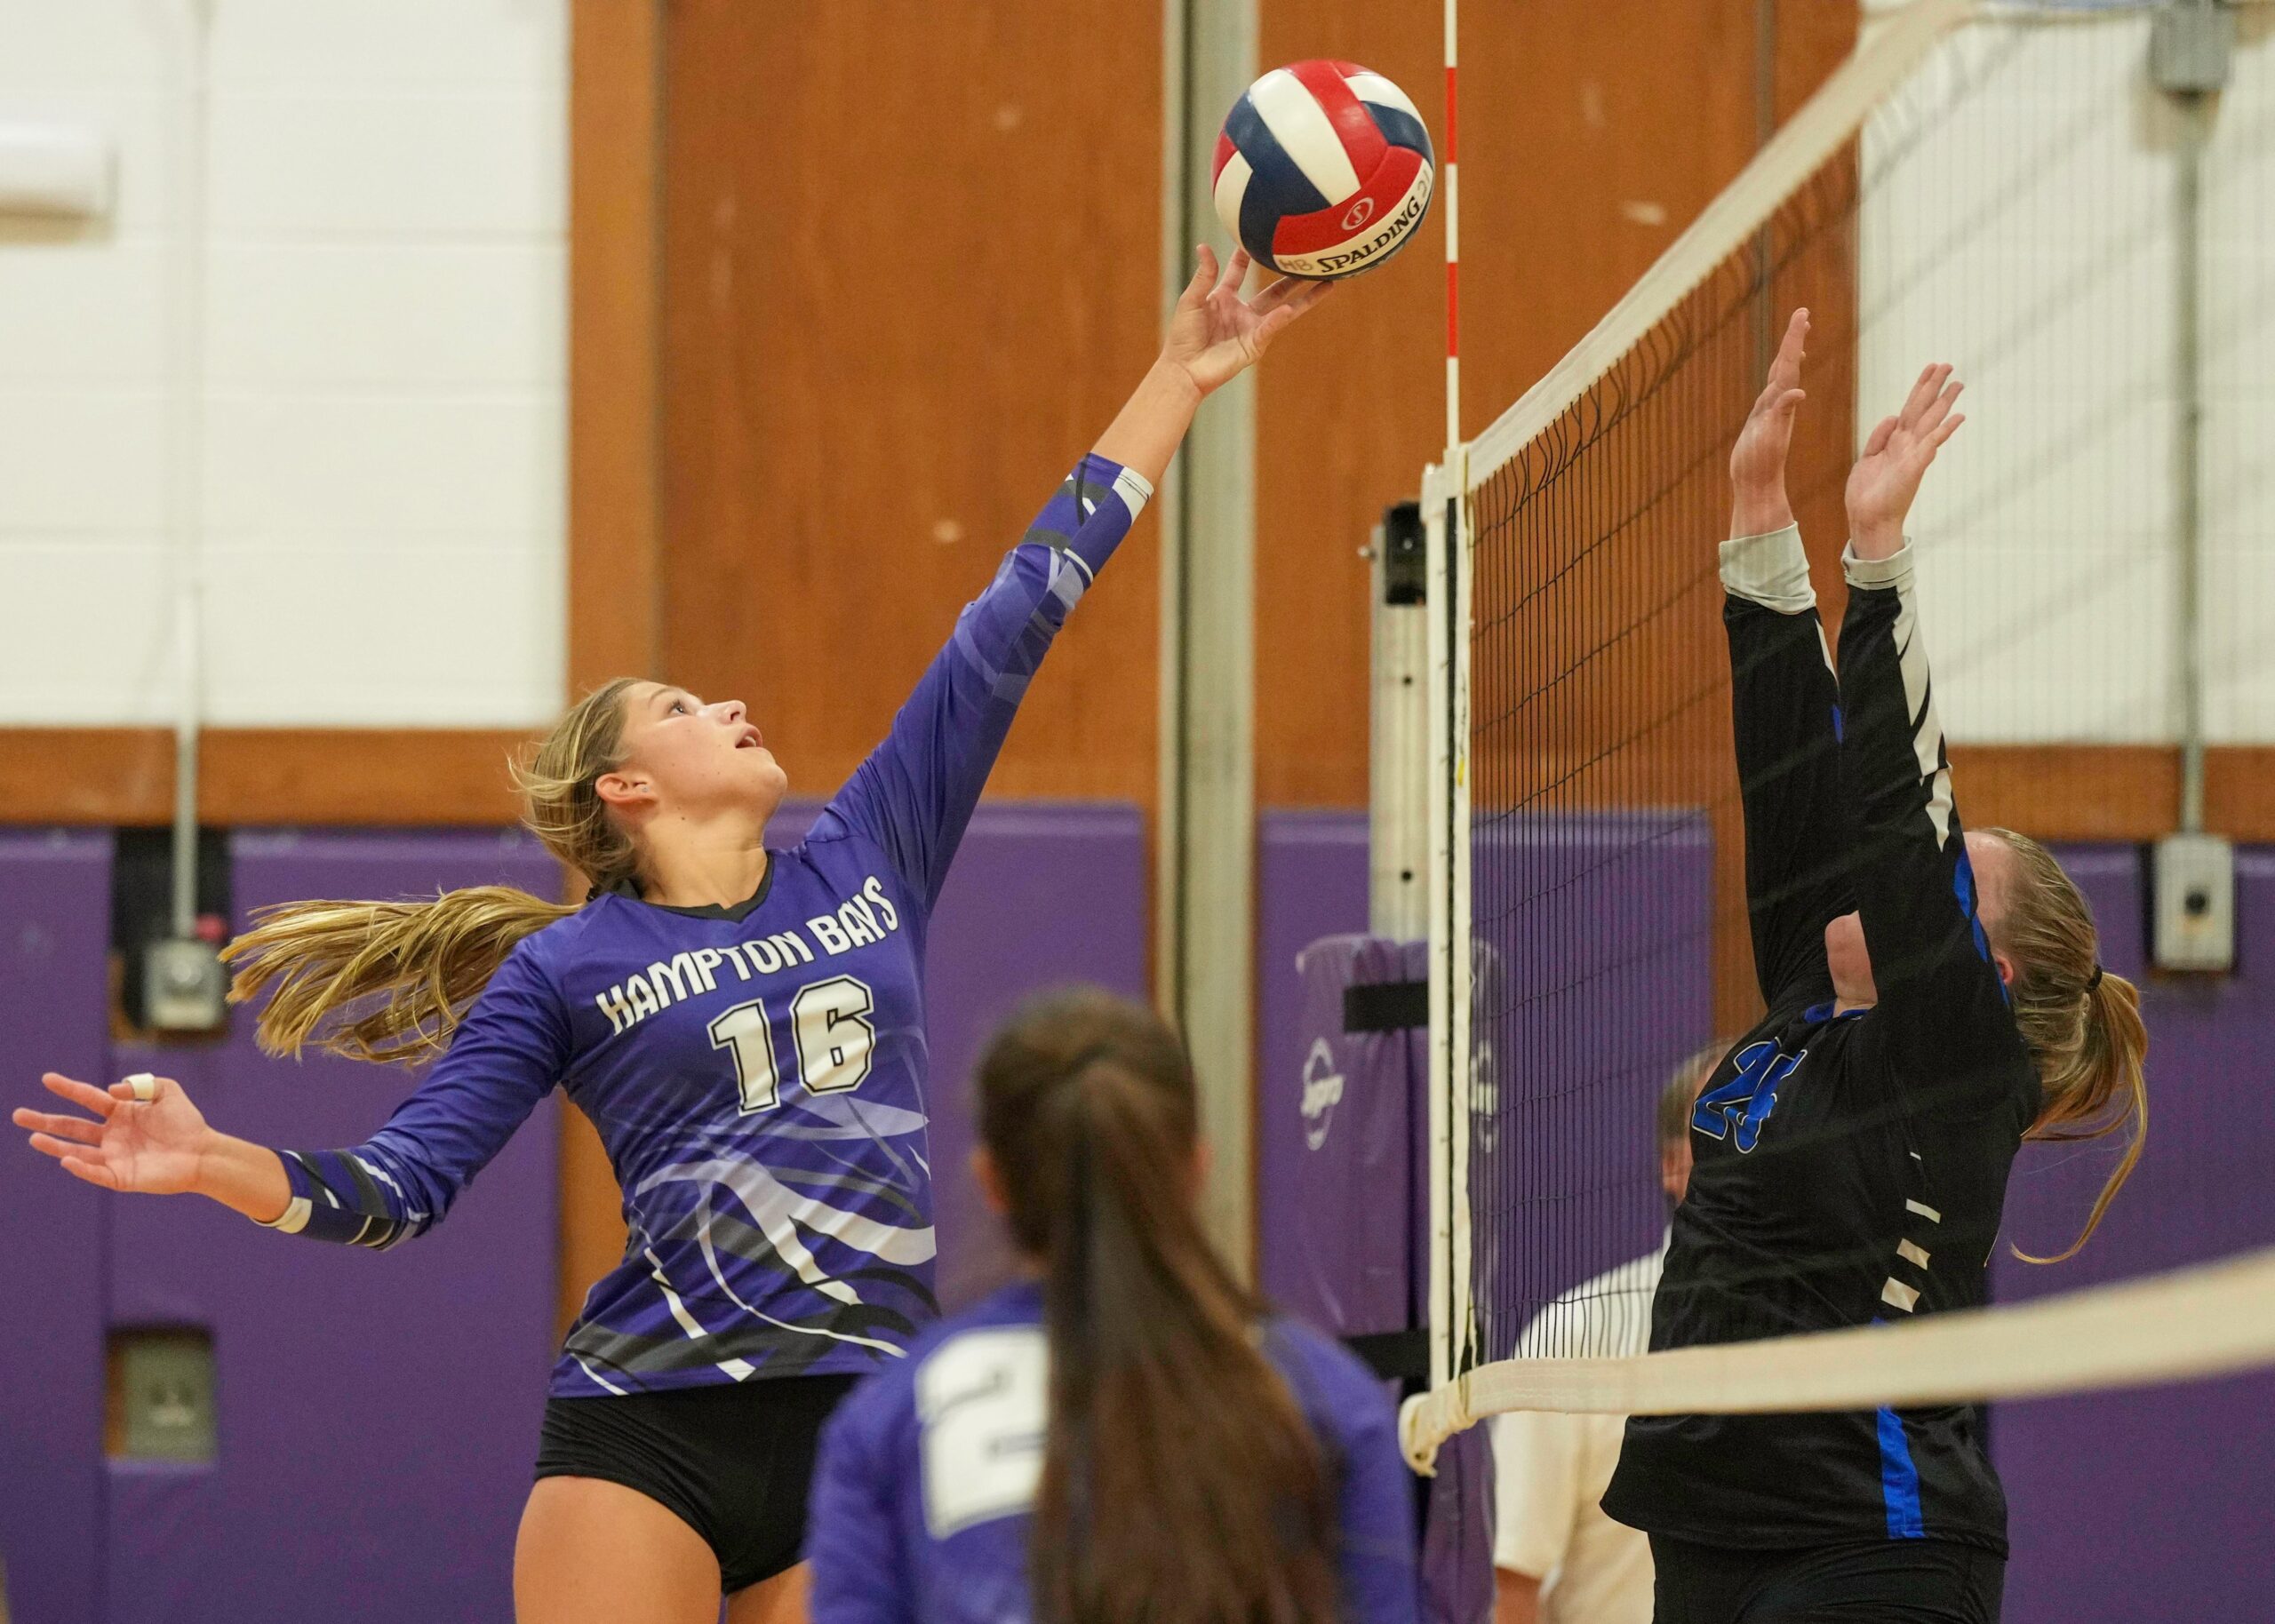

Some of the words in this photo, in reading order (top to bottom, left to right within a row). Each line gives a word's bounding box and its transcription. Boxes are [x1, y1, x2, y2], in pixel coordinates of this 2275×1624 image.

[1279, 258, 1313, 272] HB
[1317, 195, 1423, 274] SPALDING
[595, 930, 815, 1038] HAMPTON
[805, 874, 899, 957] BAYS
[706, 973, 876, 1117] 16
